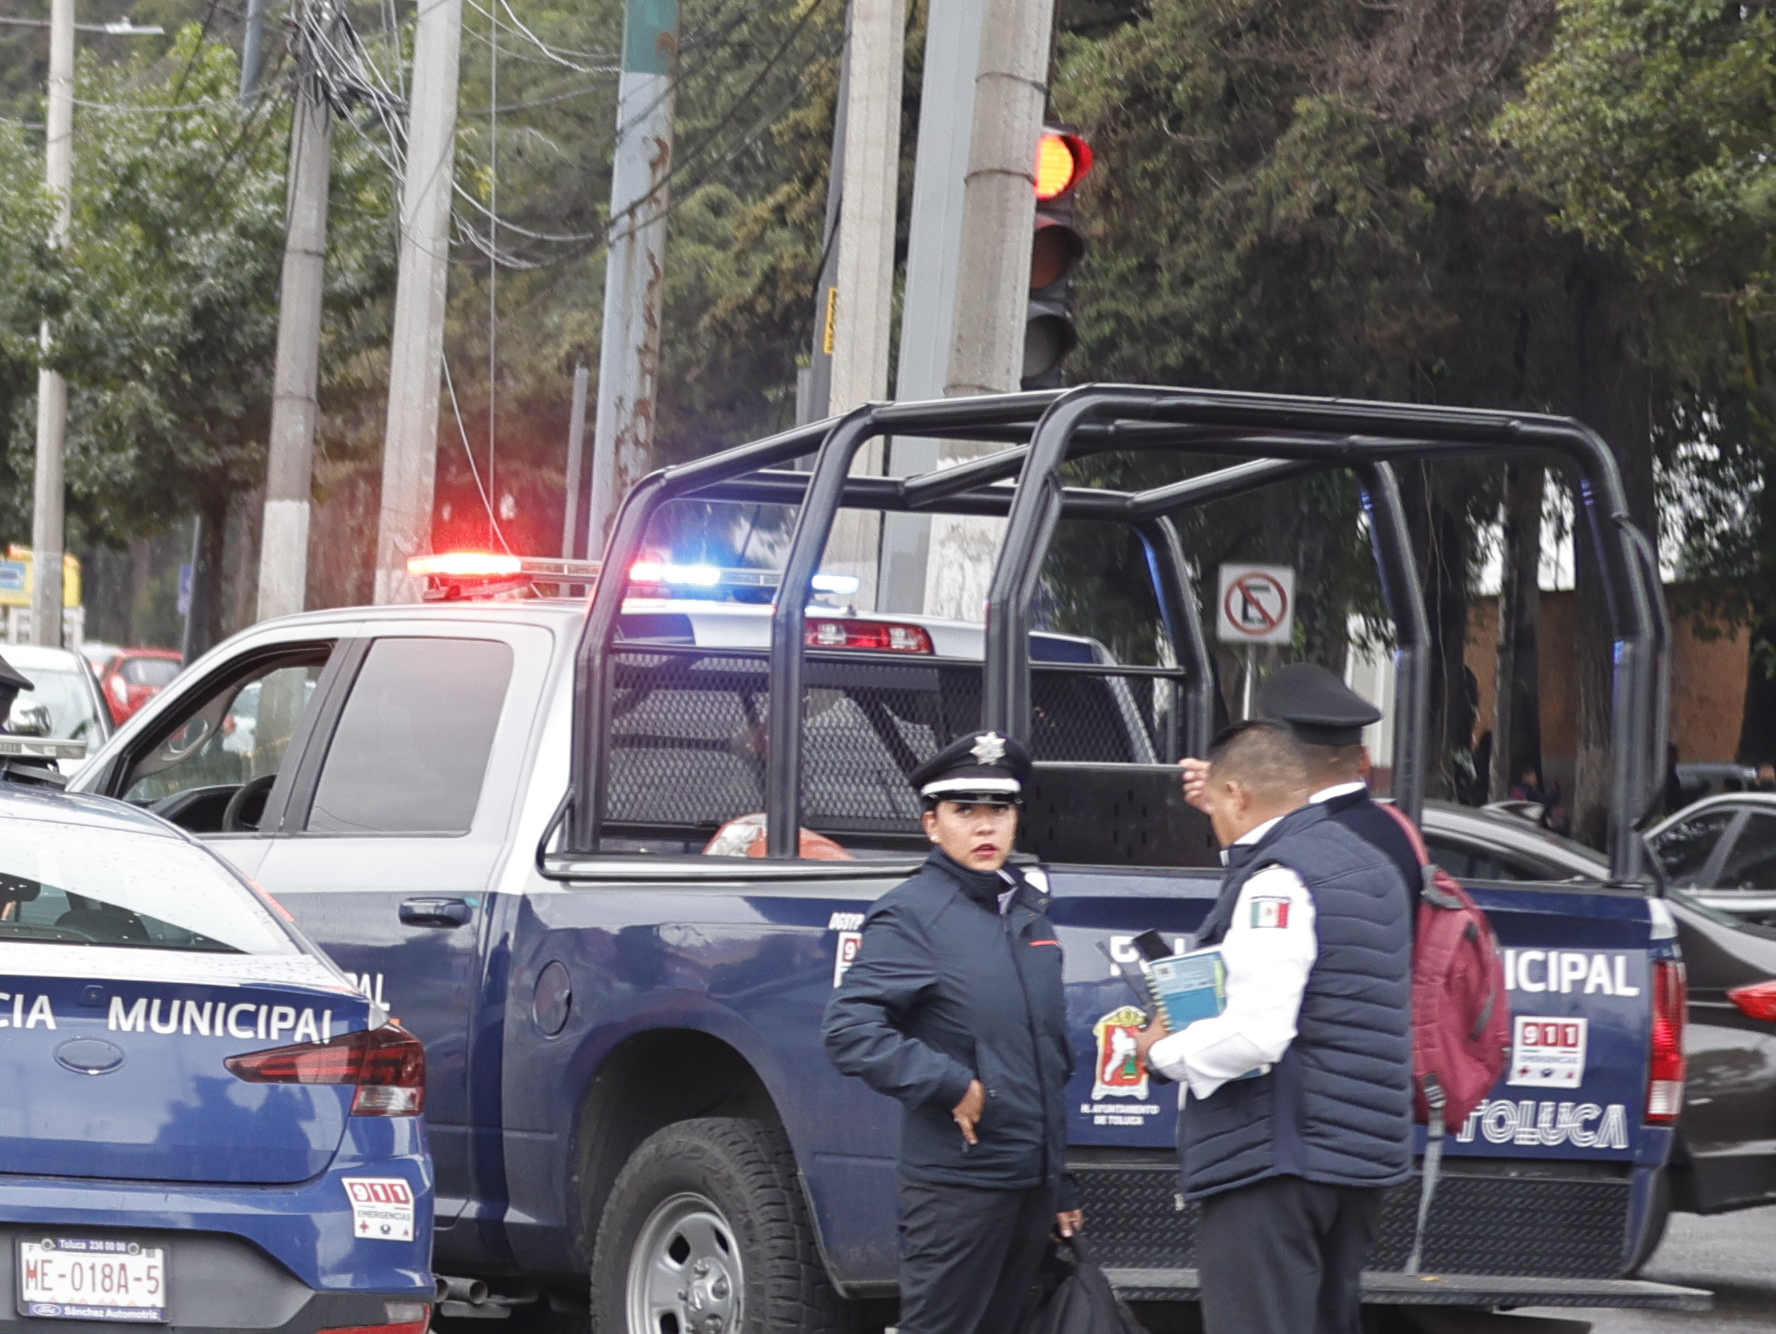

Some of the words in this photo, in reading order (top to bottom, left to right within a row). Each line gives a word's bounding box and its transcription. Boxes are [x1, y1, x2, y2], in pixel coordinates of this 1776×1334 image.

[1523, 1025, 1579, 1046] 911
[351, 1183, 408, 1202] 911
[59, 1239, 87, 1250] Toluca
[25, 1258, 160, 1295] ME-018A-5
